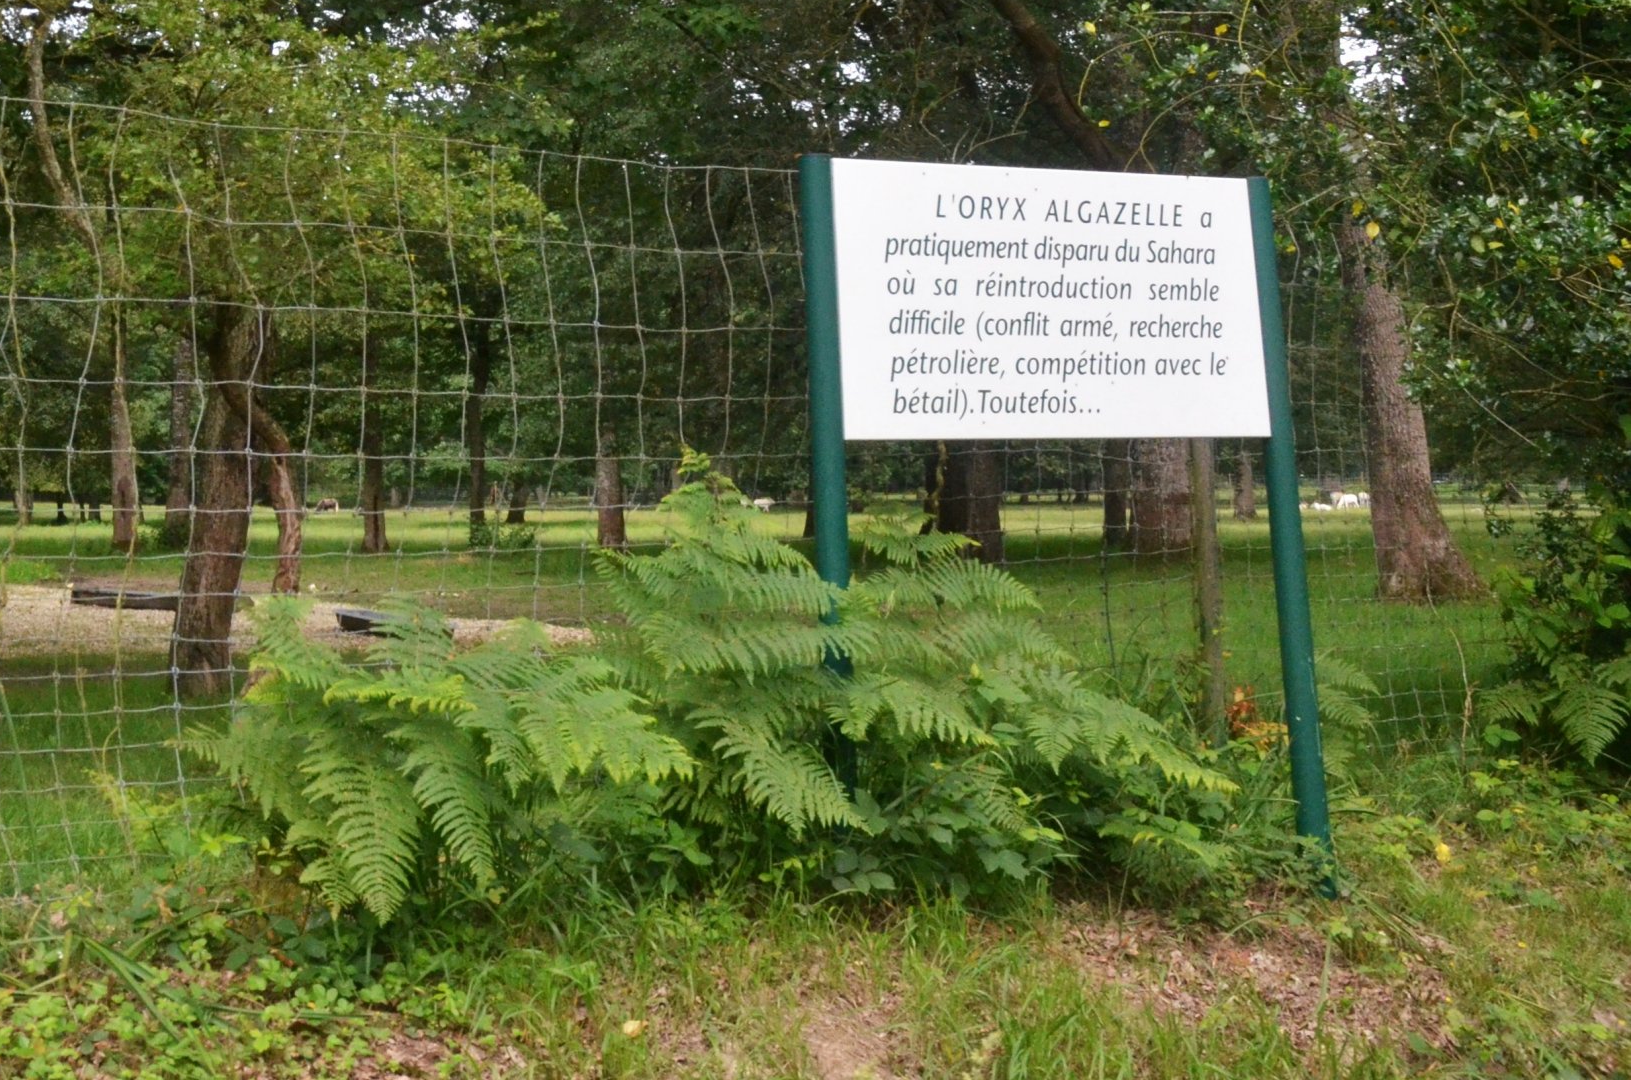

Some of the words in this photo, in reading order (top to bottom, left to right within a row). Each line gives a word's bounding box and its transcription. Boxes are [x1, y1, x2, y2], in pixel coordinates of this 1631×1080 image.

[936, 194, 1027, 221] L'ORYX
[1044, 199, 1183, 228] ALGAZELLE
[1200, 211, 1212, 229] a
[884, 232, 1029, 265] pratiquement
[1034, 235, 1109, 269] disparu
[1114, 238, 1140, 263] du
[1146, 239, 1216, 265] Sahara
[887, 269, 916, 295] où
[933, 278, 958, 296] sa
[975, 271, 1132, 300] réintroduction
[1148, 277, 1220, 302] semble
[888, 308, 966, 336] difficile
[976, 311, 1050, 342] (conflit
[1059, 312, 1118, 341] armé,
[1129, 313, 1223, 339] recherche
[890, 348, 1005, 382] pétrolière,
[1015, 350, 1146, 383] compétition
[1154, 358, 1201, 376] avec
[1210, 351, 1226, 376] le
